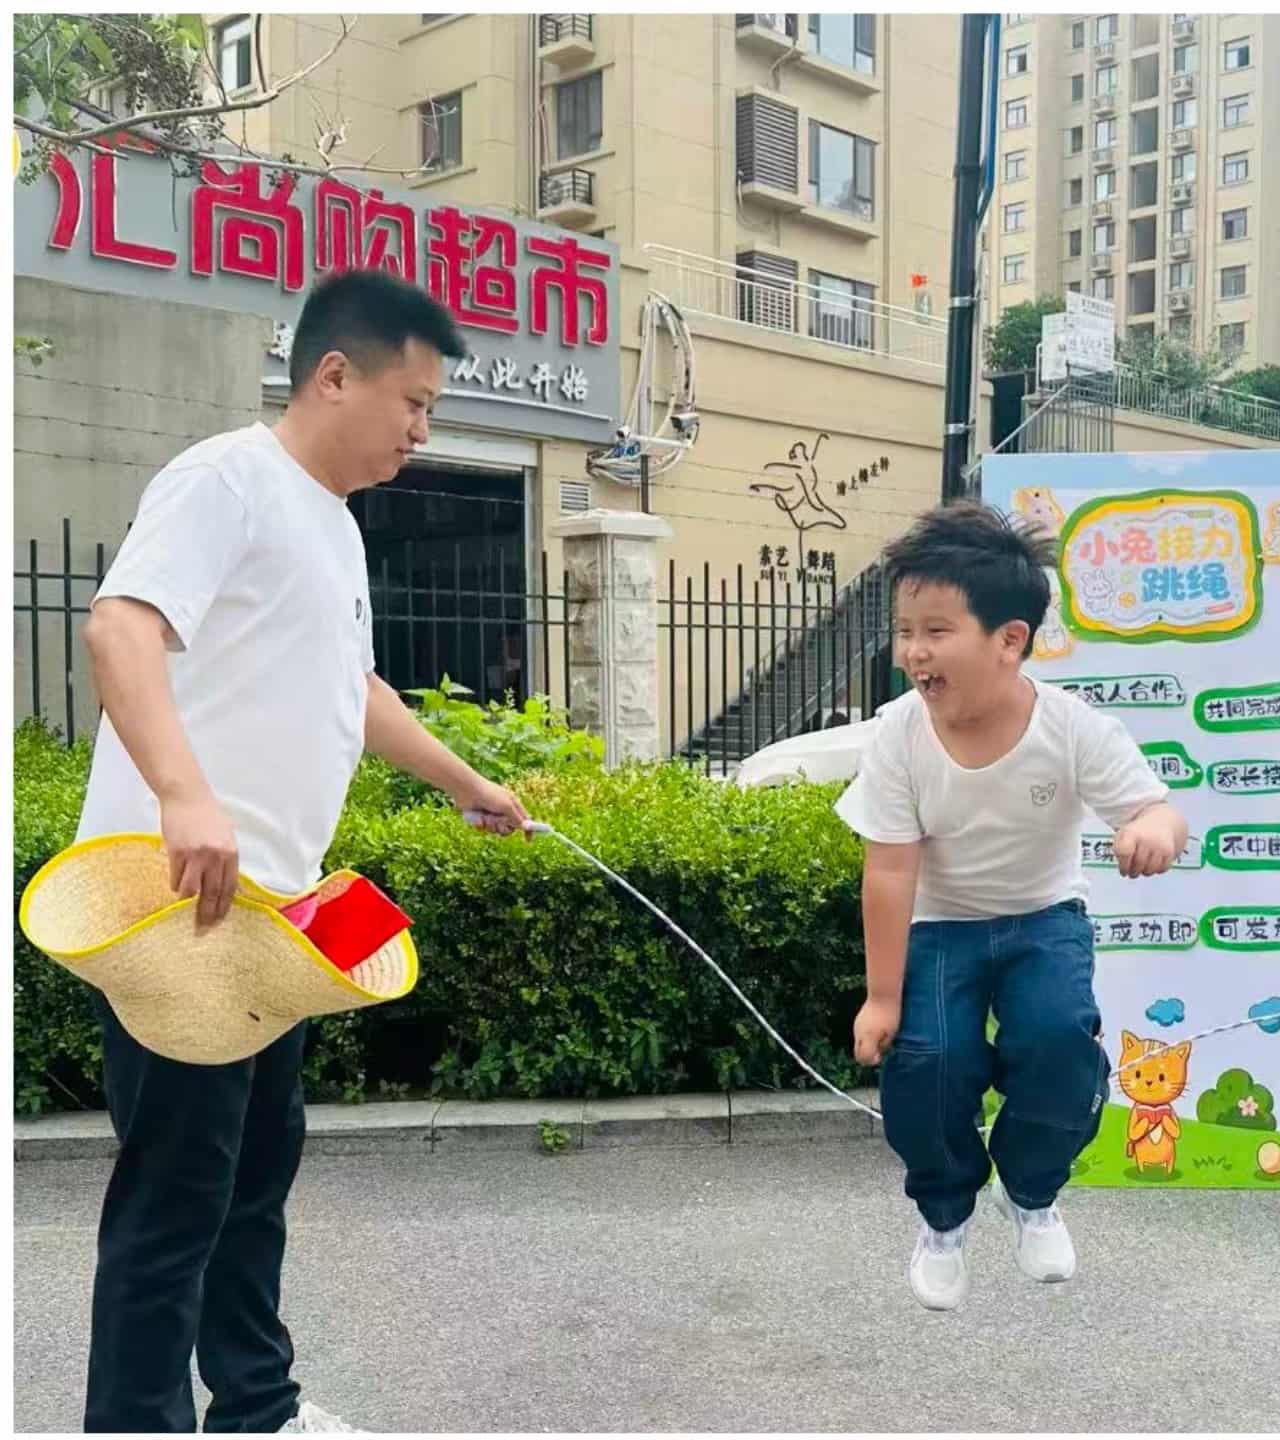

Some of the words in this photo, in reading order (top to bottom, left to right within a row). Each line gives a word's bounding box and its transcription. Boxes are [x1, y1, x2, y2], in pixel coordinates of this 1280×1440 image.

[48, 130, 612, 346] 汇尚购超市
[1079, 526, 1235, 565] 小兔接力
[1141, 562, 1231, 603] 跳绳
[1095, 919, 1192, 942] 成功即
